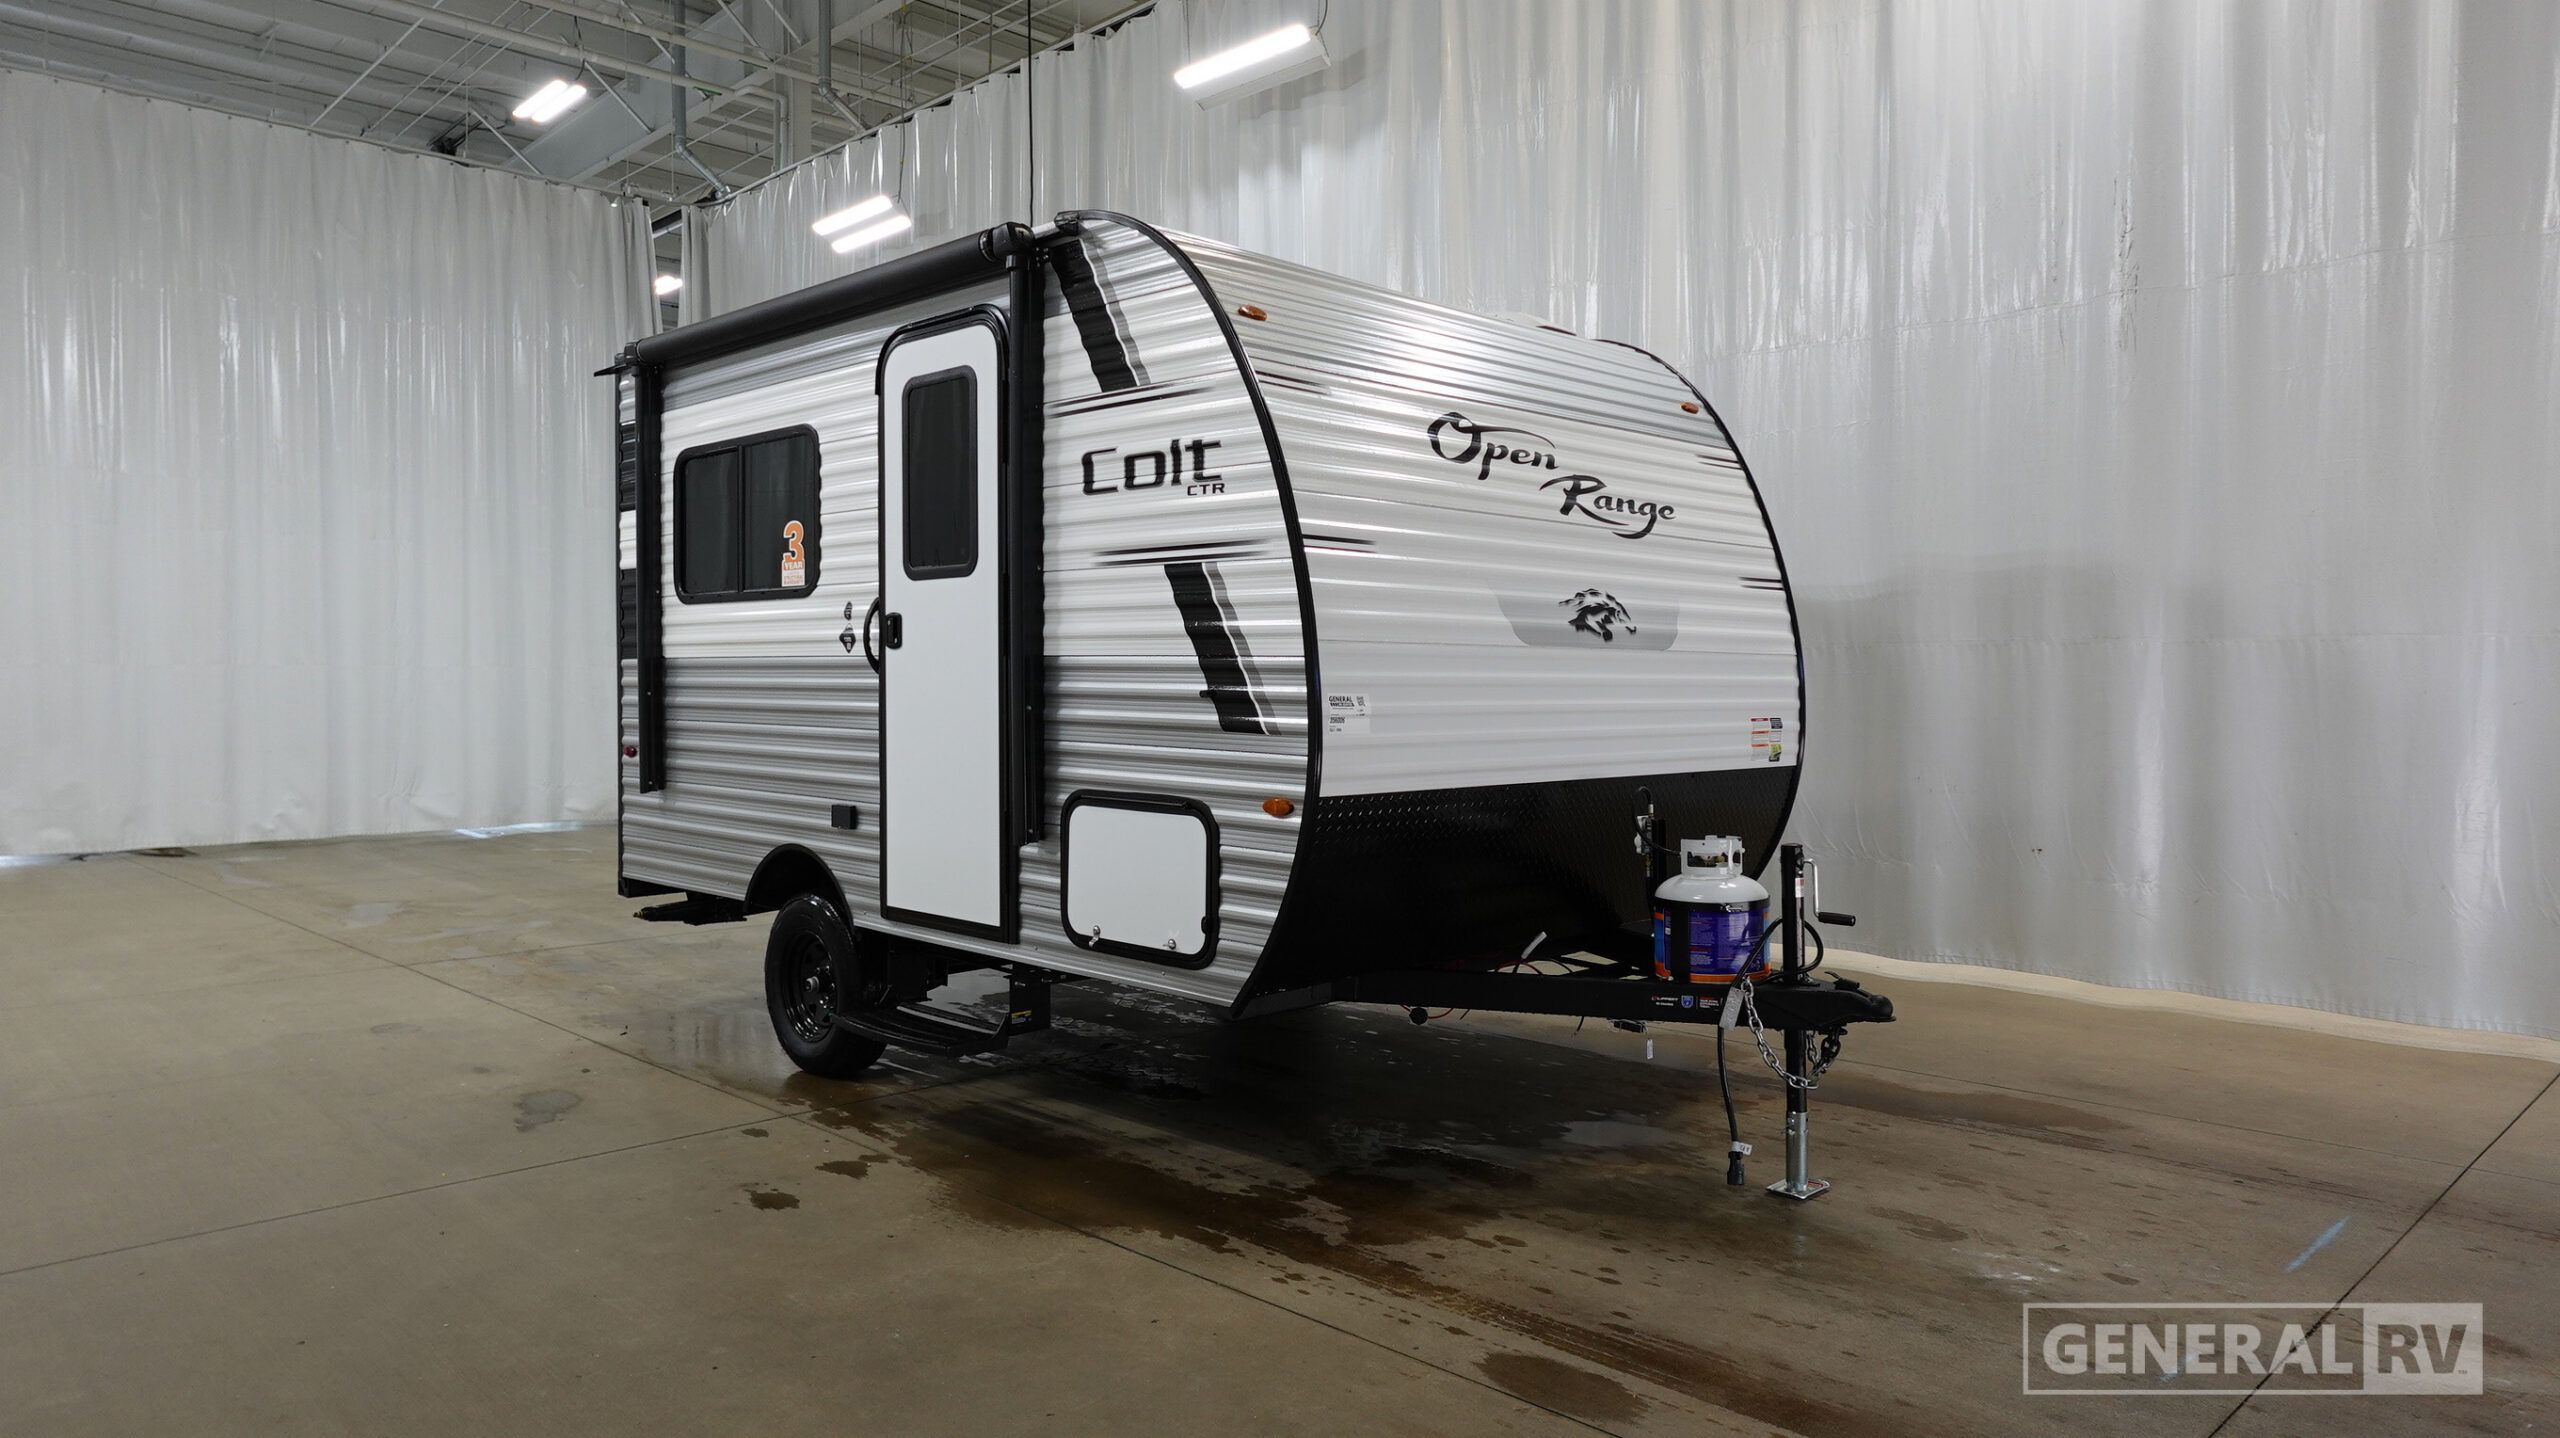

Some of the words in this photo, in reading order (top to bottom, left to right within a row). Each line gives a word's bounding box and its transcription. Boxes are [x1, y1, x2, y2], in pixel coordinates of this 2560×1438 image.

[1081, 438, 1222, 496] Colt
[1426, 411, 1559, 480] Open
[1187, 482, 1225, 496] CTR
[1539, 474, 1676, 539] Range
[783, 520, 805, 562] 3
[784, 561, 804, 570] YEAR
